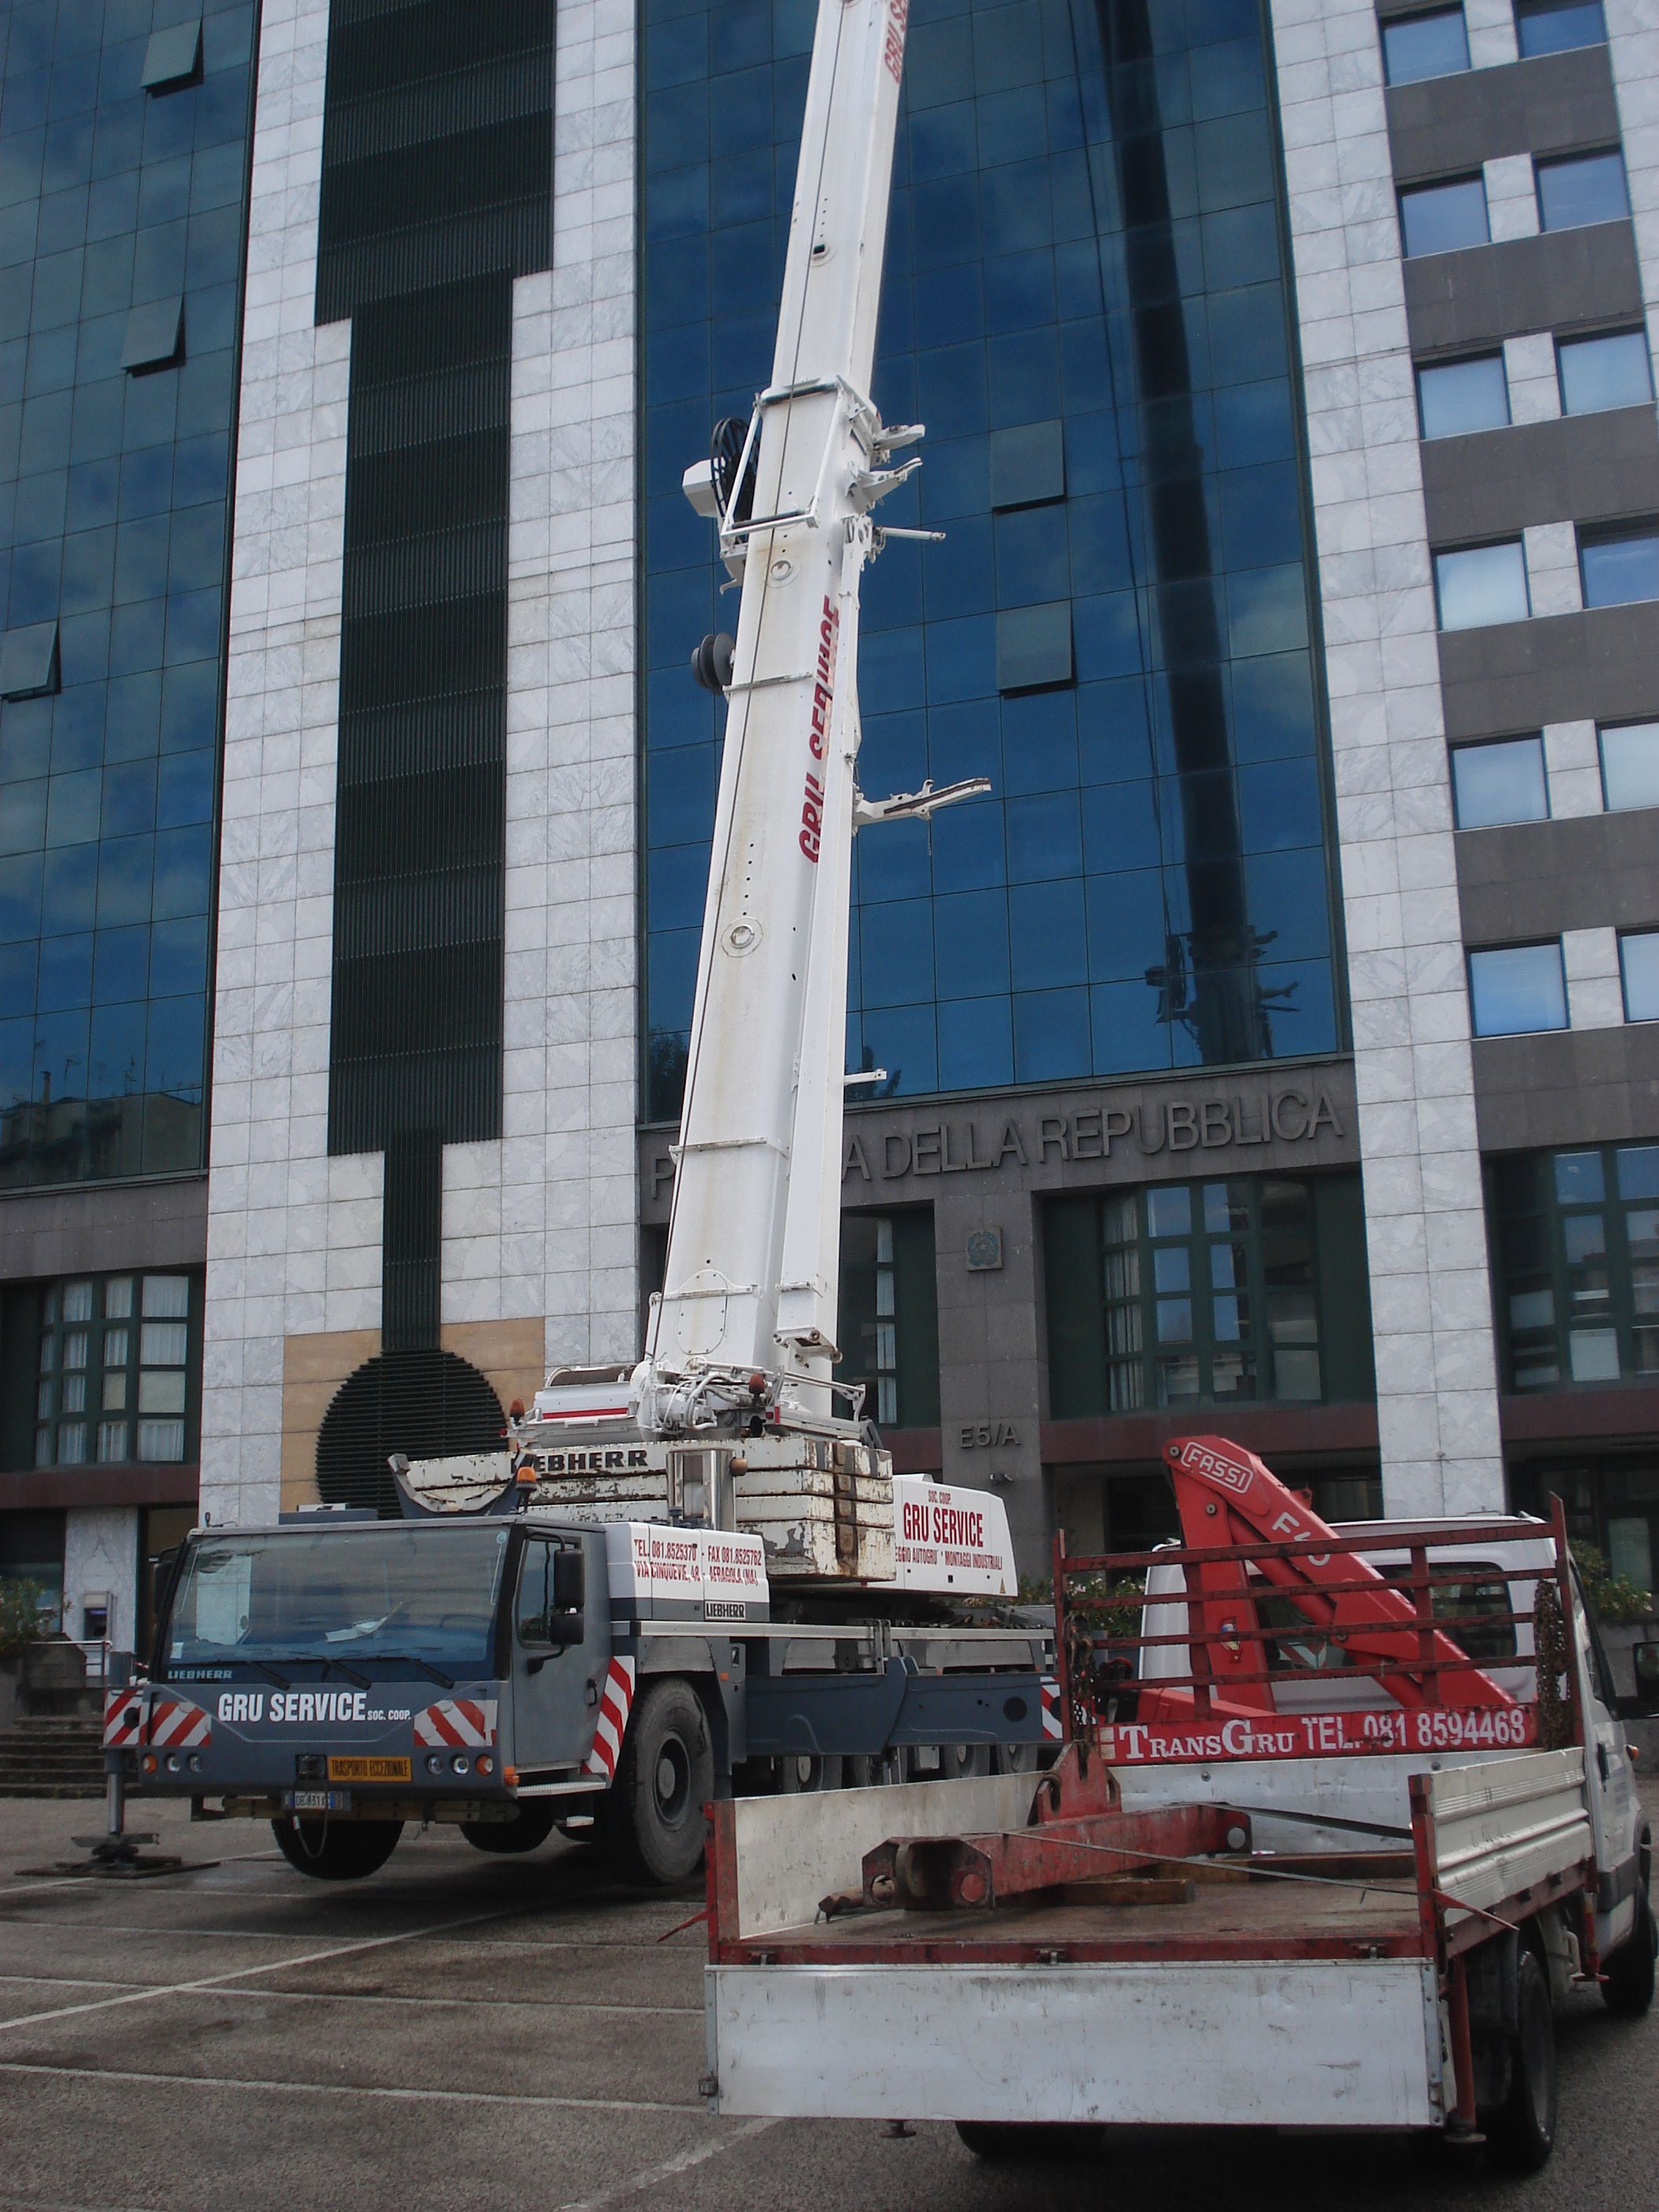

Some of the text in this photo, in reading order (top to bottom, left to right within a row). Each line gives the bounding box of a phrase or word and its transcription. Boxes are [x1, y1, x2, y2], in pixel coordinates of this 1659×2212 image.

[881, 1119, 1027, 1178] DELLA
[1036, 1087, 1344, 1164] REPUBBLICA
[960, 1423, 1022, 1448] E5/A
[1187, 1448, 1247, 1487] FASSI
[903, 1502, 983, 1547] GRU SERVICE
[708, 1545, 720, 1563] FAX
[945, 1551, 972, 1568] MONTAGGI
[972, 1553, 1003, 1570] INDUSTRIALI
[635, 1562, 650, 1578] VIA
[706, 1603, 745, 1618] LIEBHERR
[167, 1669, 233, 1679] LIEBHERR
[218, 1692, 412, 1722] GRU SERVICE SOC. COOP.
[1302, 1716, 1362, 1750] TEL.
[1364, 1712, 1407, 1748] 081
[1416, 1708, 1525, 1745] 8594468
